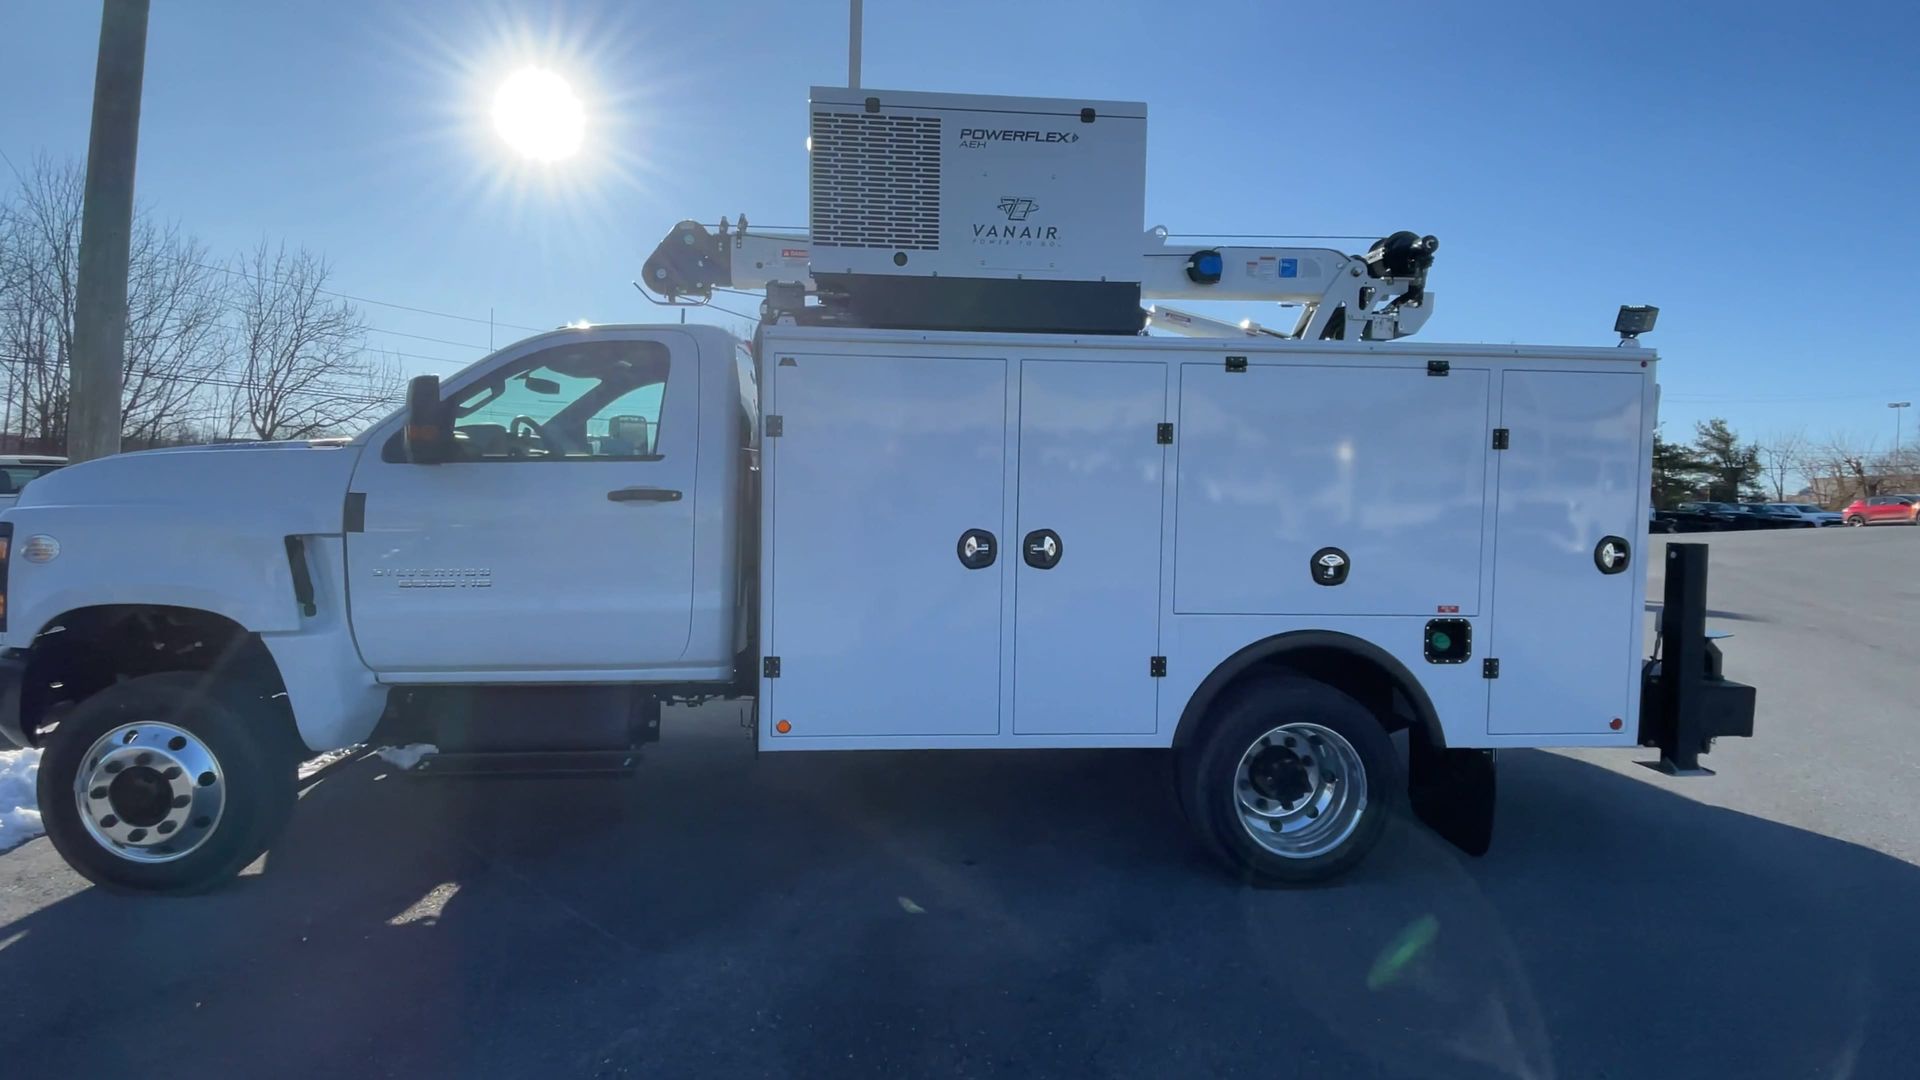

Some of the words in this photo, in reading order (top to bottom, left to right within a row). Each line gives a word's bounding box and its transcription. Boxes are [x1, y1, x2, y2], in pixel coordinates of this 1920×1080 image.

[960, 128, 1070, 143] POWERFLEX
[959, 140, 987, 149] AEH
[973, 223, 1058, 240] VANAIR
